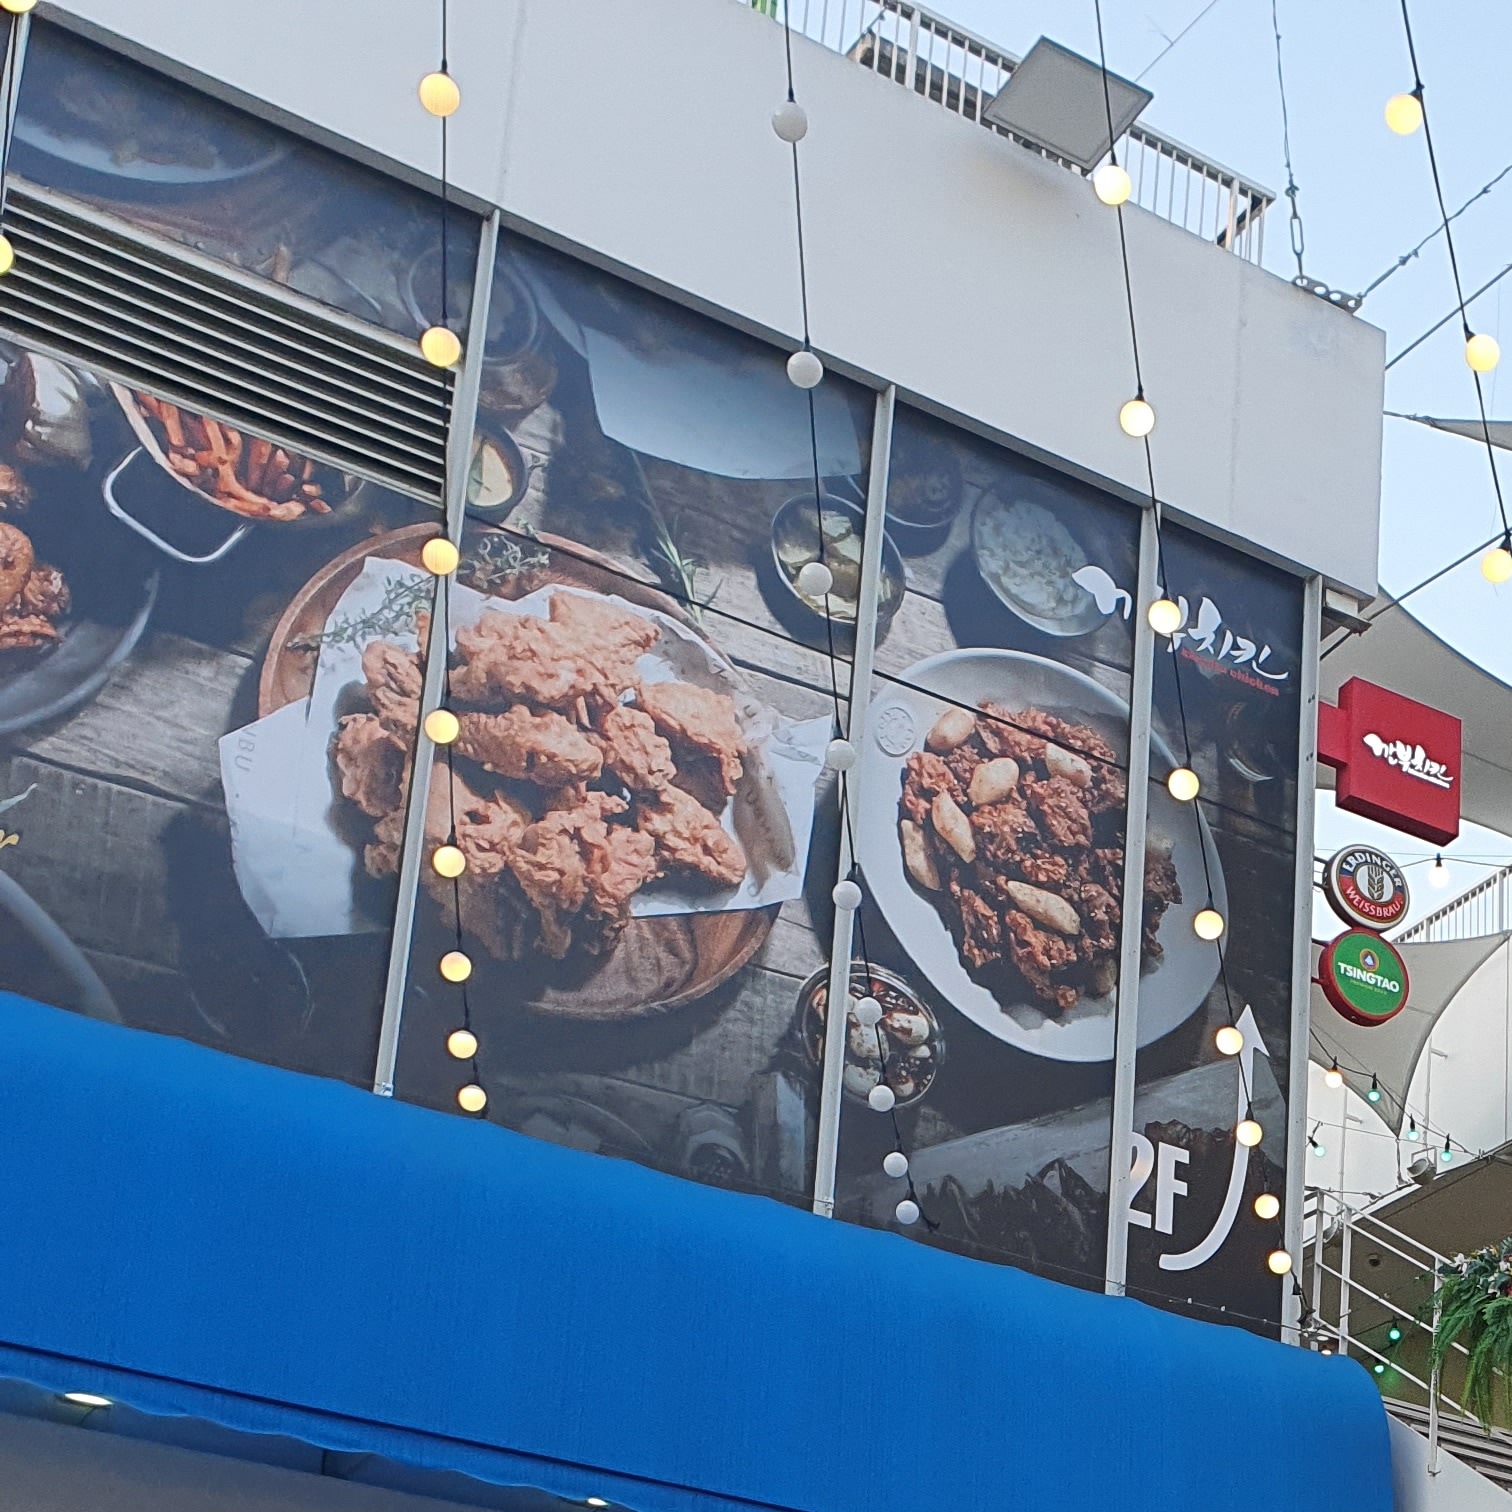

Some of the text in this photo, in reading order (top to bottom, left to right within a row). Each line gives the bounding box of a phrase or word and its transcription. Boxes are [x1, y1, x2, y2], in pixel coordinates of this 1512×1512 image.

[1363, 733, 1454, 782] 깐부치킨
[1342, 853, 1401, 887] ERDINGER
[1338, 962, 1400, 993] TSINGTAO
[1128, 1131, 1190, 1234] 2F
